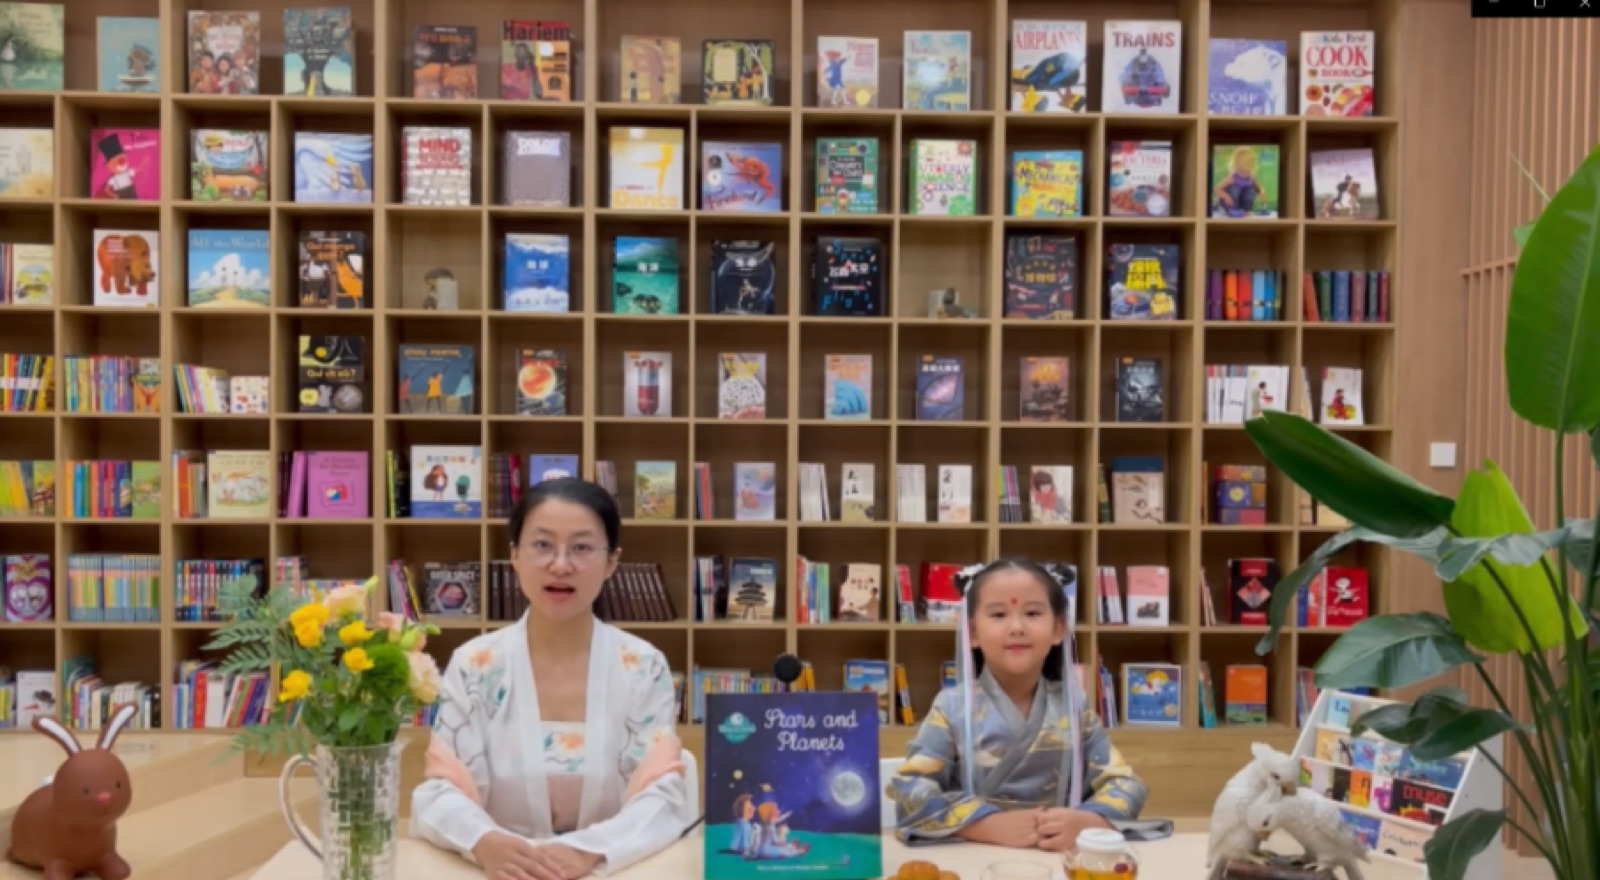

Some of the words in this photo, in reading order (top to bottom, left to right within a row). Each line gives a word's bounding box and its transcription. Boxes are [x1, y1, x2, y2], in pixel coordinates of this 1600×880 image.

[503, 20, 570, 41] Harlem
[1111, 31, 1175, 49] TRAINS
[1306, 45, 1368, 67] COOK
[418, 138, 460, 152] MIND
[764, 708, 816, 729] Stars
[822, 709, 859, 729] and
[777, 731, 845, 751] Planets
[1403, 784, 1447, 804] muse
